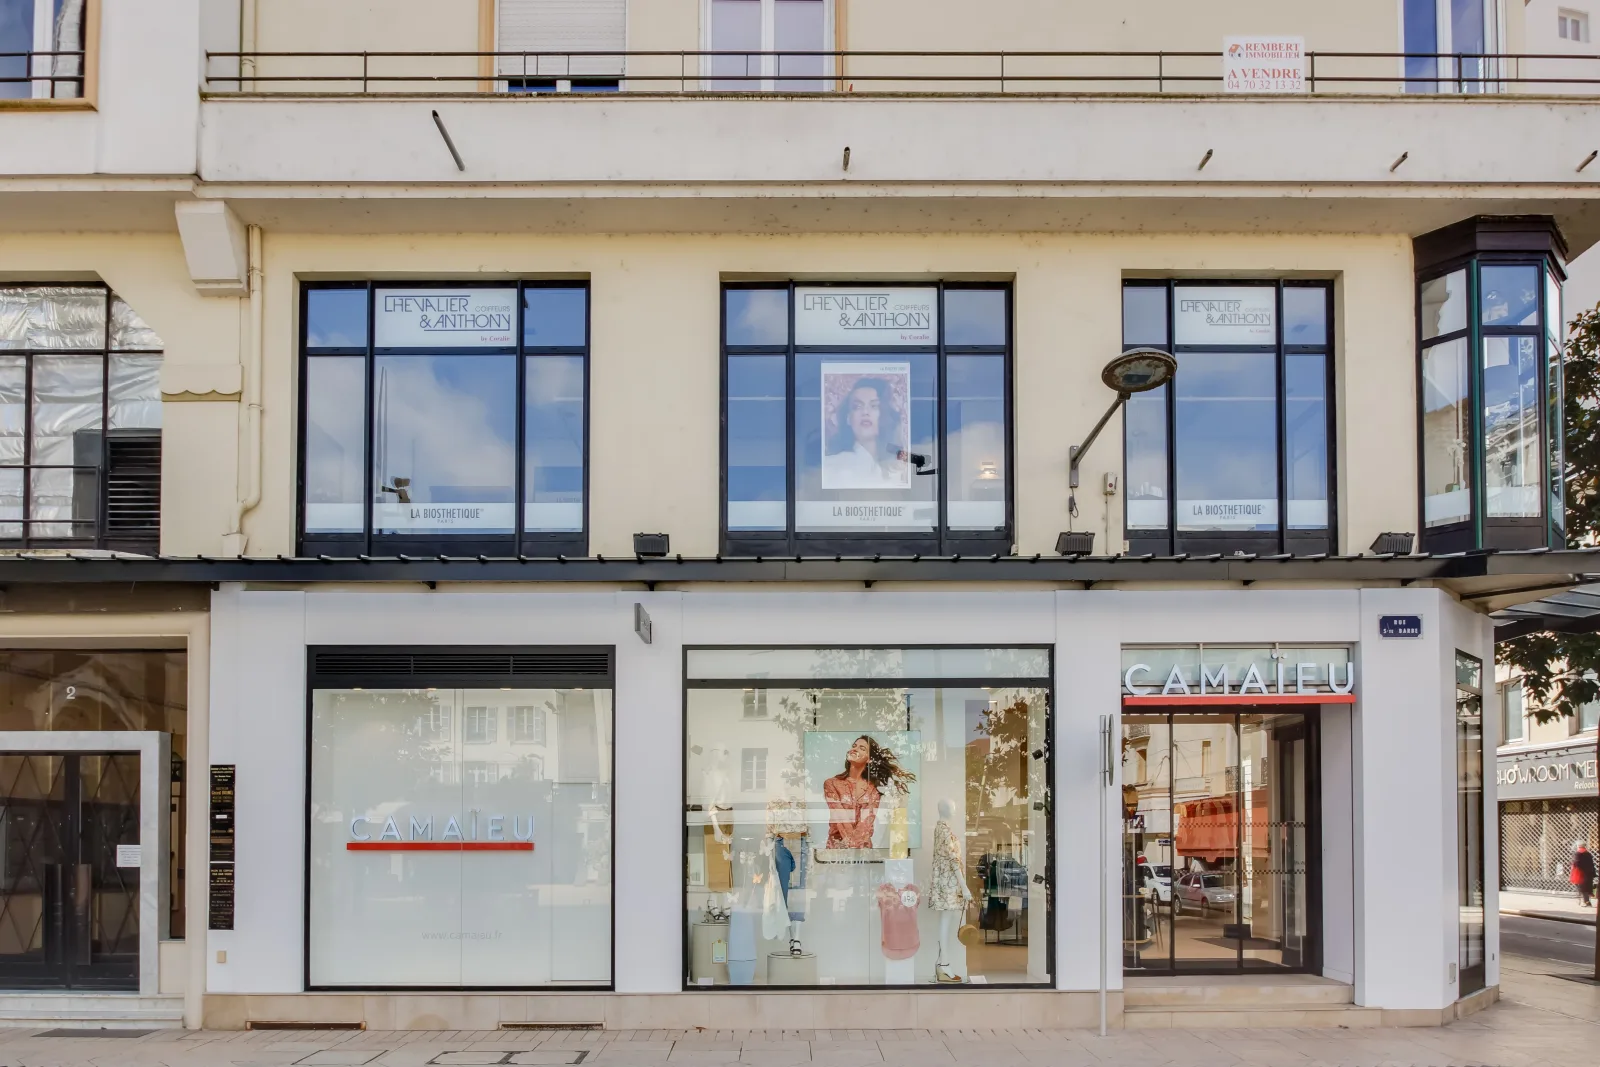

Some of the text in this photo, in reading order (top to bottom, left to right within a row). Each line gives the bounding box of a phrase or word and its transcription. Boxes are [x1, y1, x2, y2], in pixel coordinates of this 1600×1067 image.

[1245, 43, 1300, 52] REMBERT
[1245, 51, 1300, 59] IMMOBILIER
[1228, 68, 1301, 80] A VENDRE
[1228, 80, 1301, 90] 04 70 32 13 32
[384, 295, 511, 313] CHEVALIER COIFFEURS
[803, 293, 890, 311] CHEVALIER
[1180, 299, 1242, 312] CHEVALIER
[410, 508, 480, 519] LA BIOSTHETIQUE
[832, 506, 903, 517] LA BIOSTHETIQUE
[1193, 504, 1262, 516] LA BIOSTHETIQUE
[66, 686, 76, 700] 2
